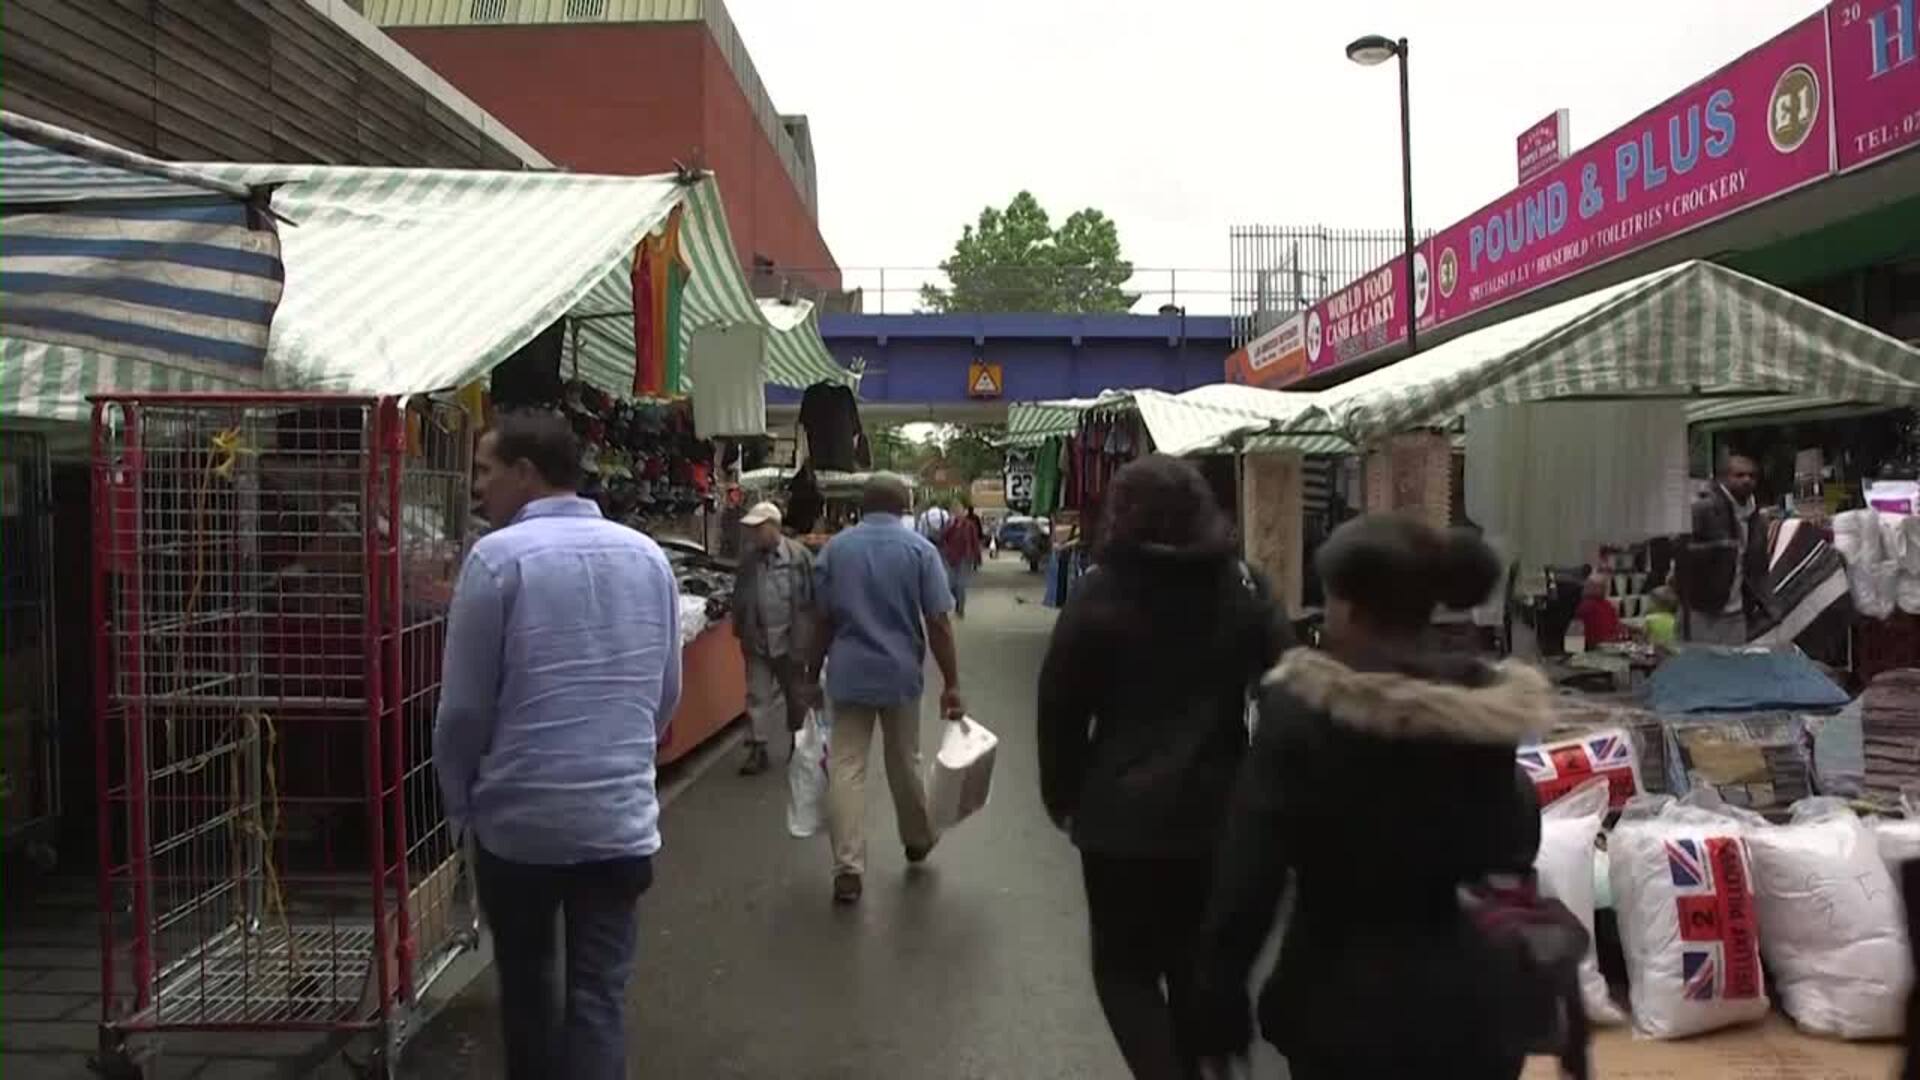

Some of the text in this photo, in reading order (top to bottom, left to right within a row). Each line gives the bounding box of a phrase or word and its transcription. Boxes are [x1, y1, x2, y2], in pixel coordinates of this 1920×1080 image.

[1841, 3, 1861, 27] 20
[1775, 85, 1810, 132] £1
[1854, 121, 1899, 153] TEL:
[1469, 88, 1736, 271] POUND & PLUS
[1537, 235, 1588, 275] HOUSEHOLD
[1597, 204, 1663, 248] TOILETRIES
[1672, 168, 1748, 217] CROCKERY
[1326, 314, 1350, 347] CASH
[1351, 312, 1360, 338] &
[1360, 290, 1397, 333] CARRY
[1327, 267, 1393, 321] WORLD FOOD
[1691, 911, 1714, 928] 2
